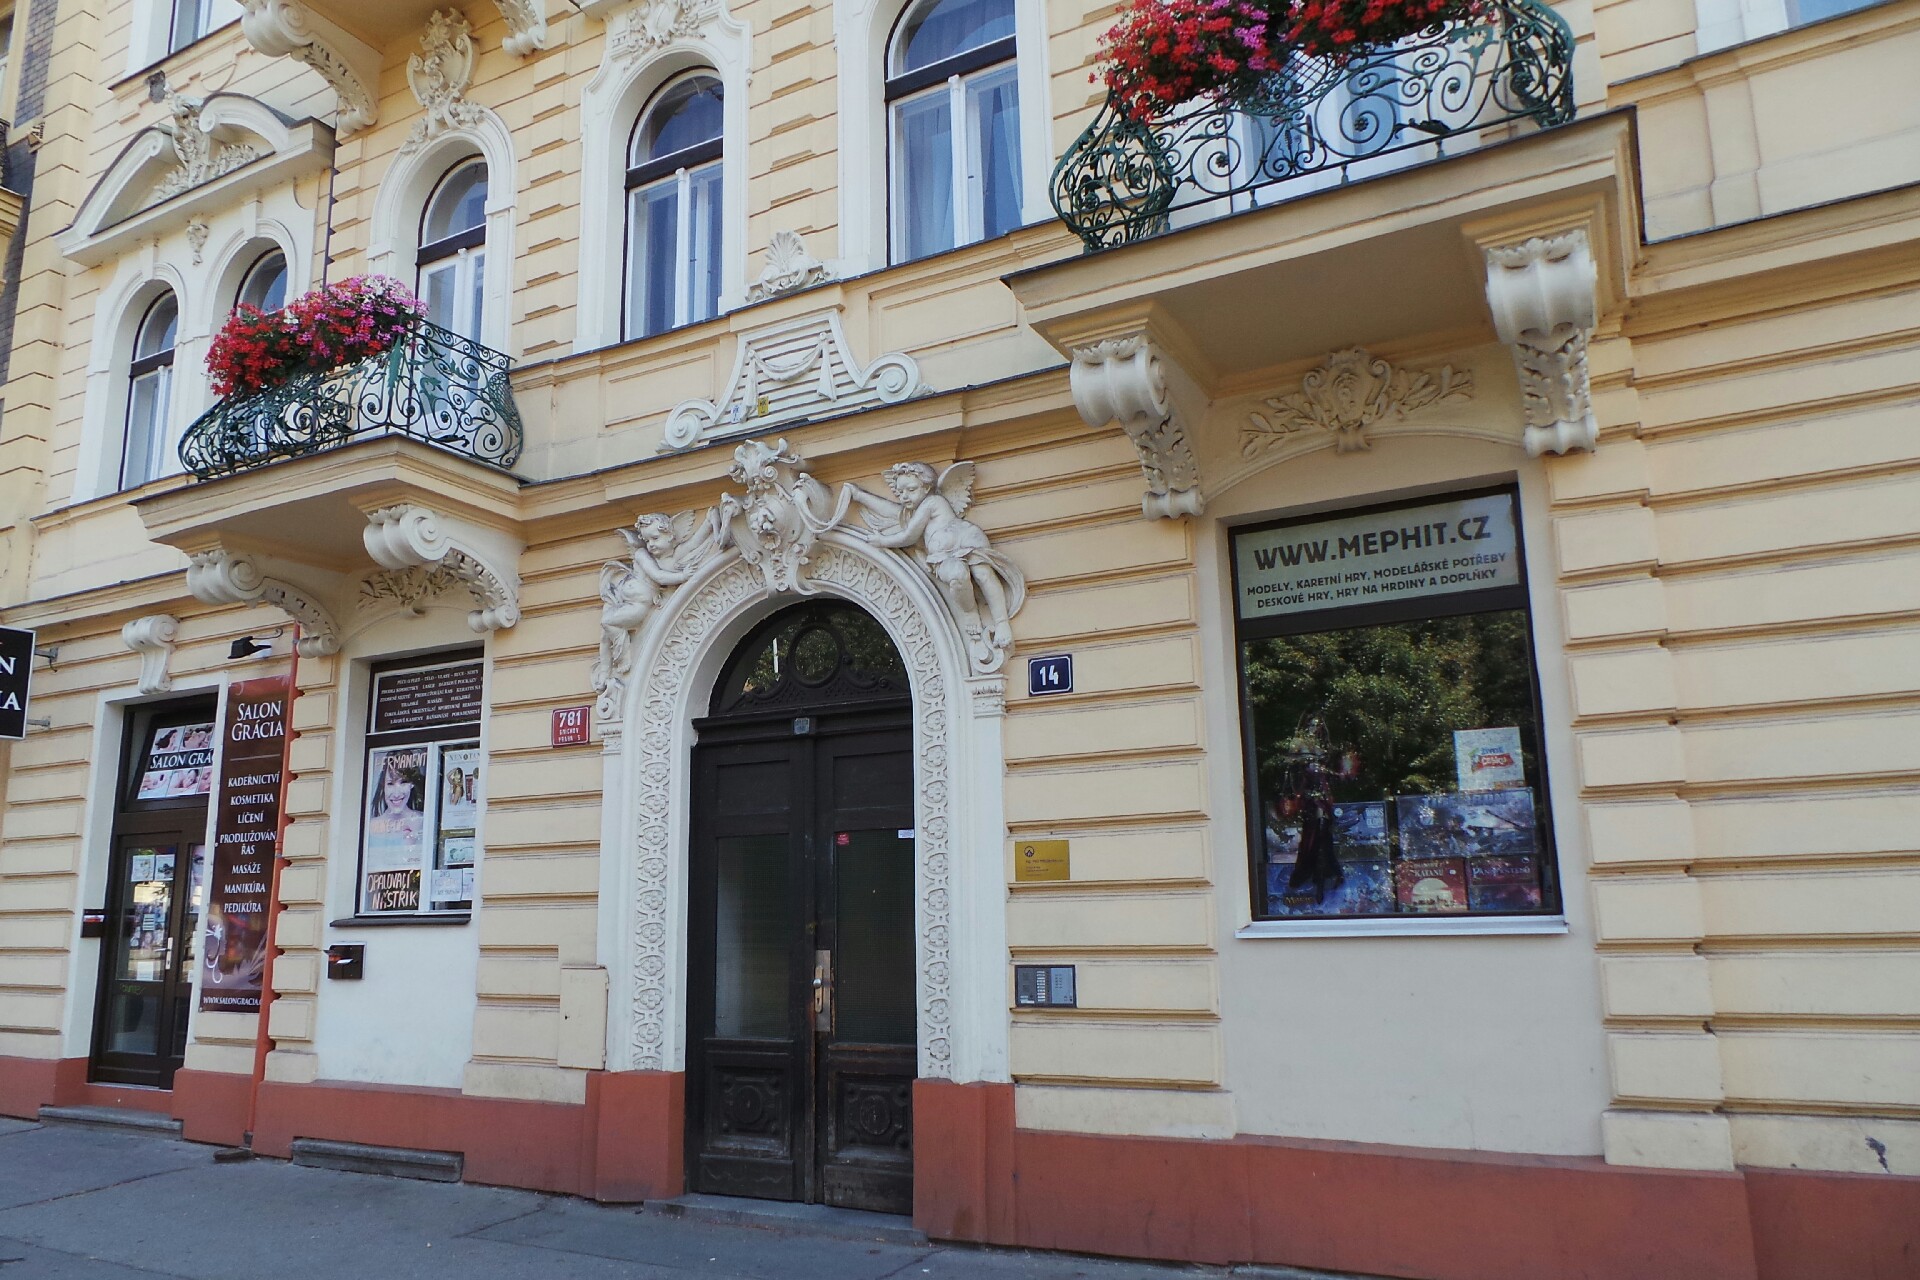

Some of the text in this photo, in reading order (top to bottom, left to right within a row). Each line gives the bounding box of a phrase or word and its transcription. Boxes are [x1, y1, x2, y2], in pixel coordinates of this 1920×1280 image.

[1253, 515, 1491, 571] WWW.MEPHIT.CZ
[1247, 552, 1506, 596] MODELY, KARETNÍ HRY, MODELÁŘSKÉ POTŘEBY
[1257, 567, 1497, 609] DESKOVÉ HRY, HRY NA HRDINY A DOPLŇKY
[1040, 665, 1058, 685] 14
[237, 700, 282, 721] SALON
[560, 710, 581, 727] 781
[231, 720, 284, 741] GRÁCIA
[150, 748, 214, 769] SALON GRÁ
[228, 771, 280, 787] KADEŘNICTVÍ
[230, 793, 274, 806] KOSMETIKA
[238, 810, 264, 824] LÍČENÍ
[220, 829, 277, 844] PRODLUŽOVÁN
[241, 844, 255, 855] ŘAS
[232, 862, 261, 874] MASÁŽE
[224, 880, 266, 894] MANIKÚRA
[224, 900, 263, 913] PEDIKÚRA
